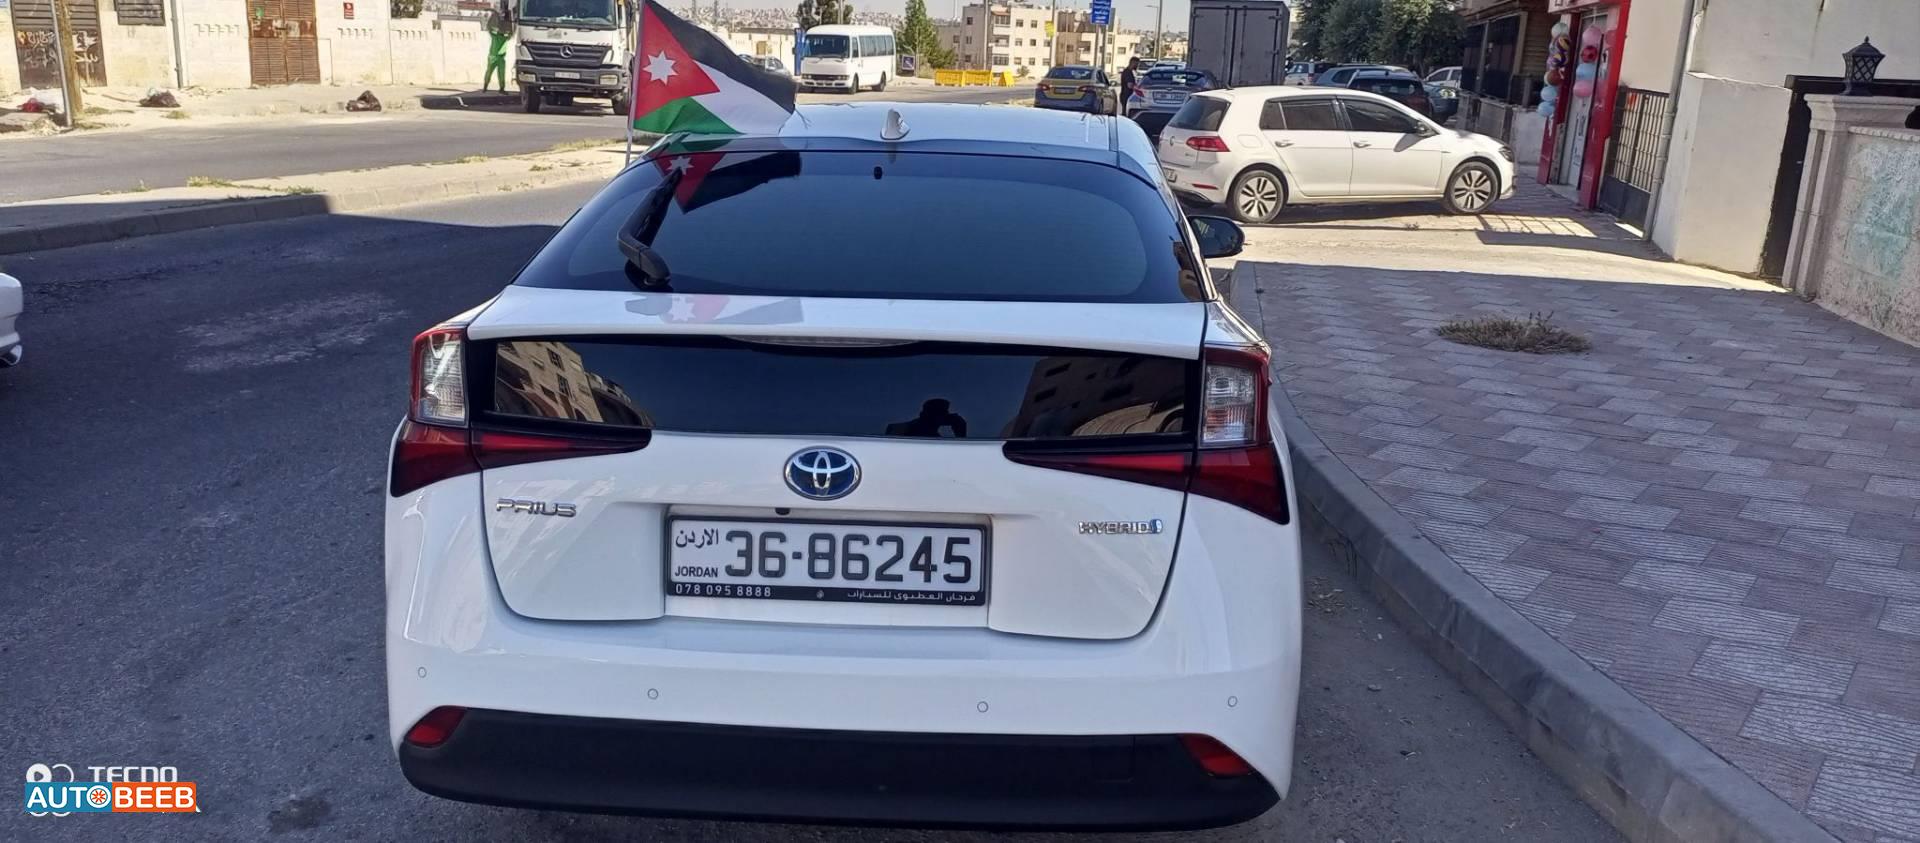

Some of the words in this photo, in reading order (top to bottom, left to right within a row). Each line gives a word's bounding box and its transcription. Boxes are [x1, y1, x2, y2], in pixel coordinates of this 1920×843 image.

[496, 498, 577, 518] PRIUS
[1078, 520, 1152, 535] HYBRID
[724, 530, 972, 584] 36-86245
[674, 566, 719, 578] JORDAN
[675, 583, 701, 595] 078
[706, 585, 732, 596] 095
[736, 586, 772, 597] 8888
